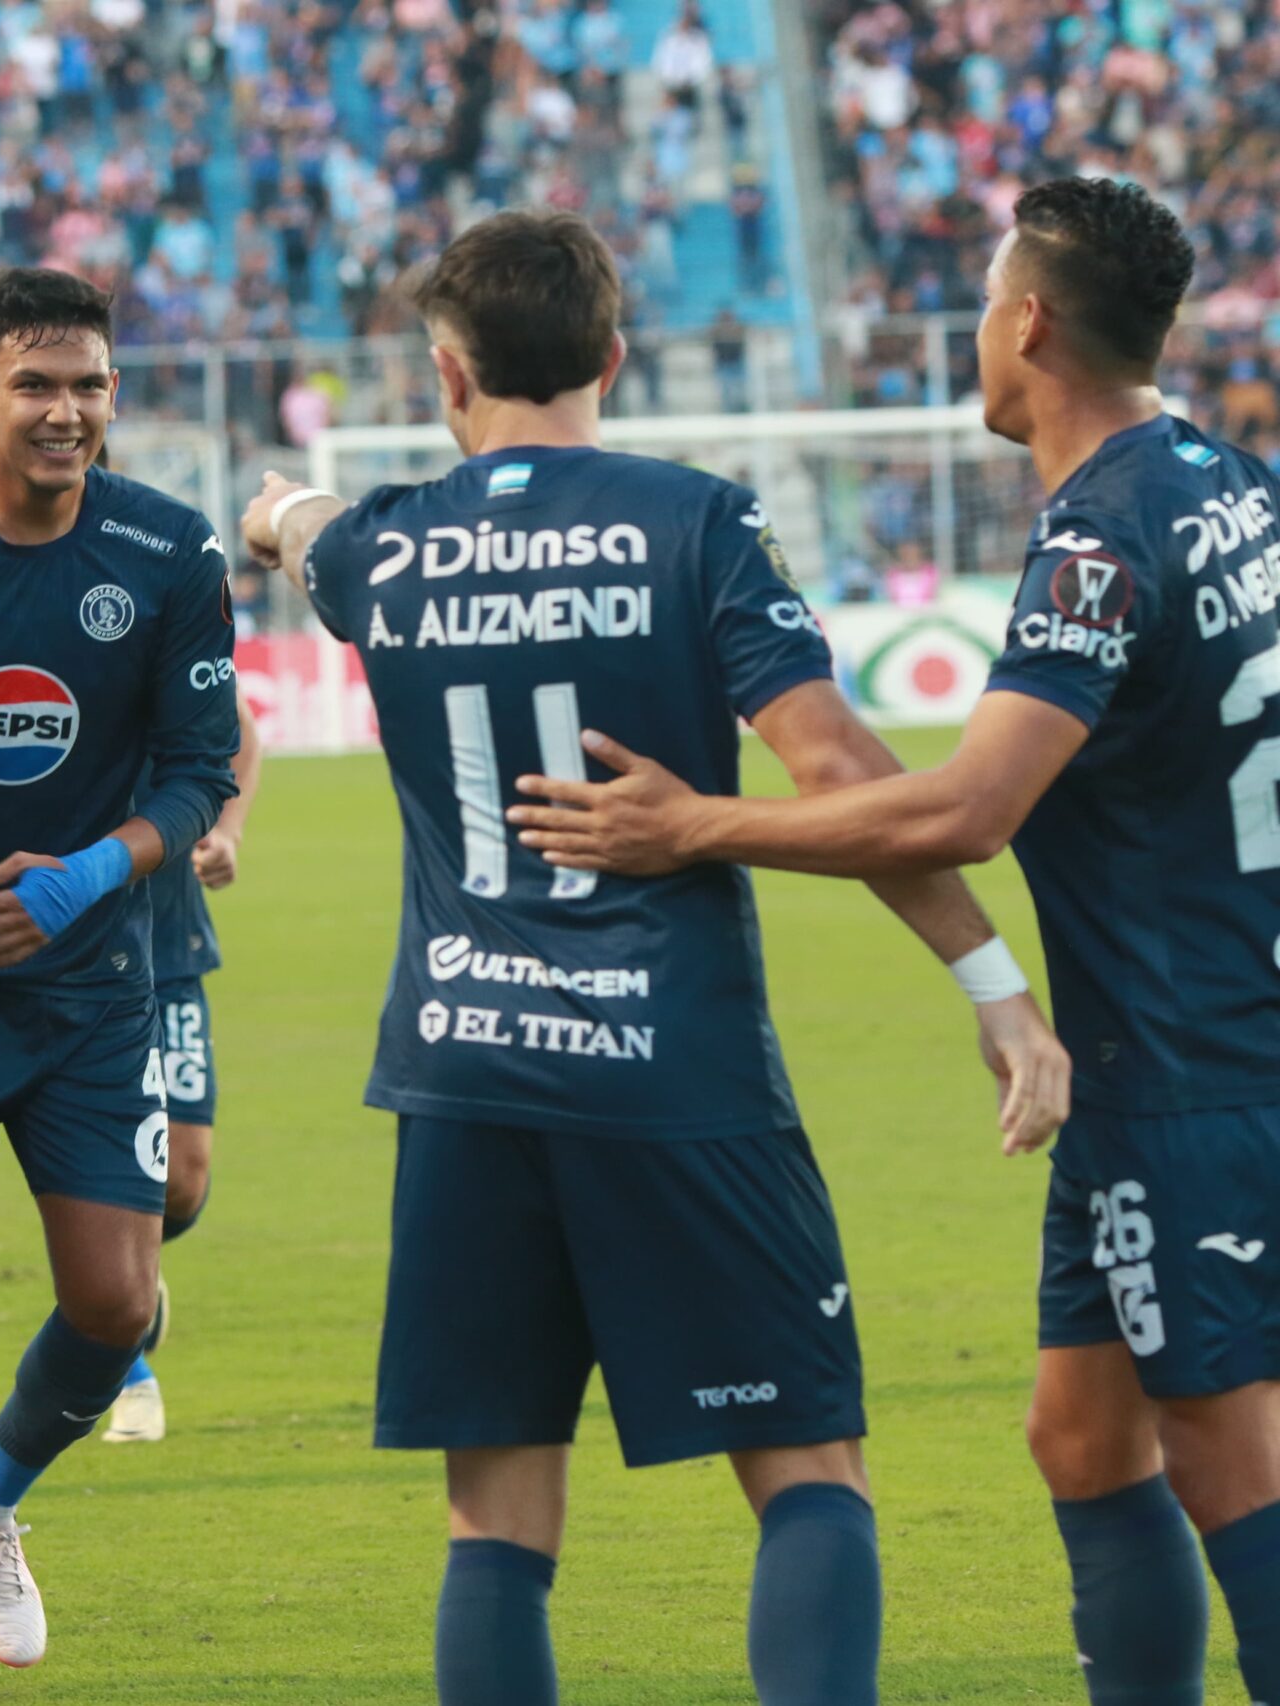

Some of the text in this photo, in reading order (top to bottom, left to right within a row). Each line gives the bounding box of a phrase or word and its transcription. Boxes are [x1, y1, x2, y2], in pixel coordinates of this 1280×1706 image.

[101, 518, 175, 554] HONDUBET
[421, 520, 648, 579] Diunsa
[368, 585, 652, 650] A. AUZMENDI
[1017, 611, 1126, 669] Claro
[189, 656, 236, 690] Cla
[443, 682, 599, 899] 11
[470, 951, 650, 998] ULTRACEM
[166, 1002, 205, 1050] 12
[452, 1005, 656, 1060] EL TITAN
[142, 1046, 167, 1109] 4
[1090, 1179, 1156, 1269] 26
